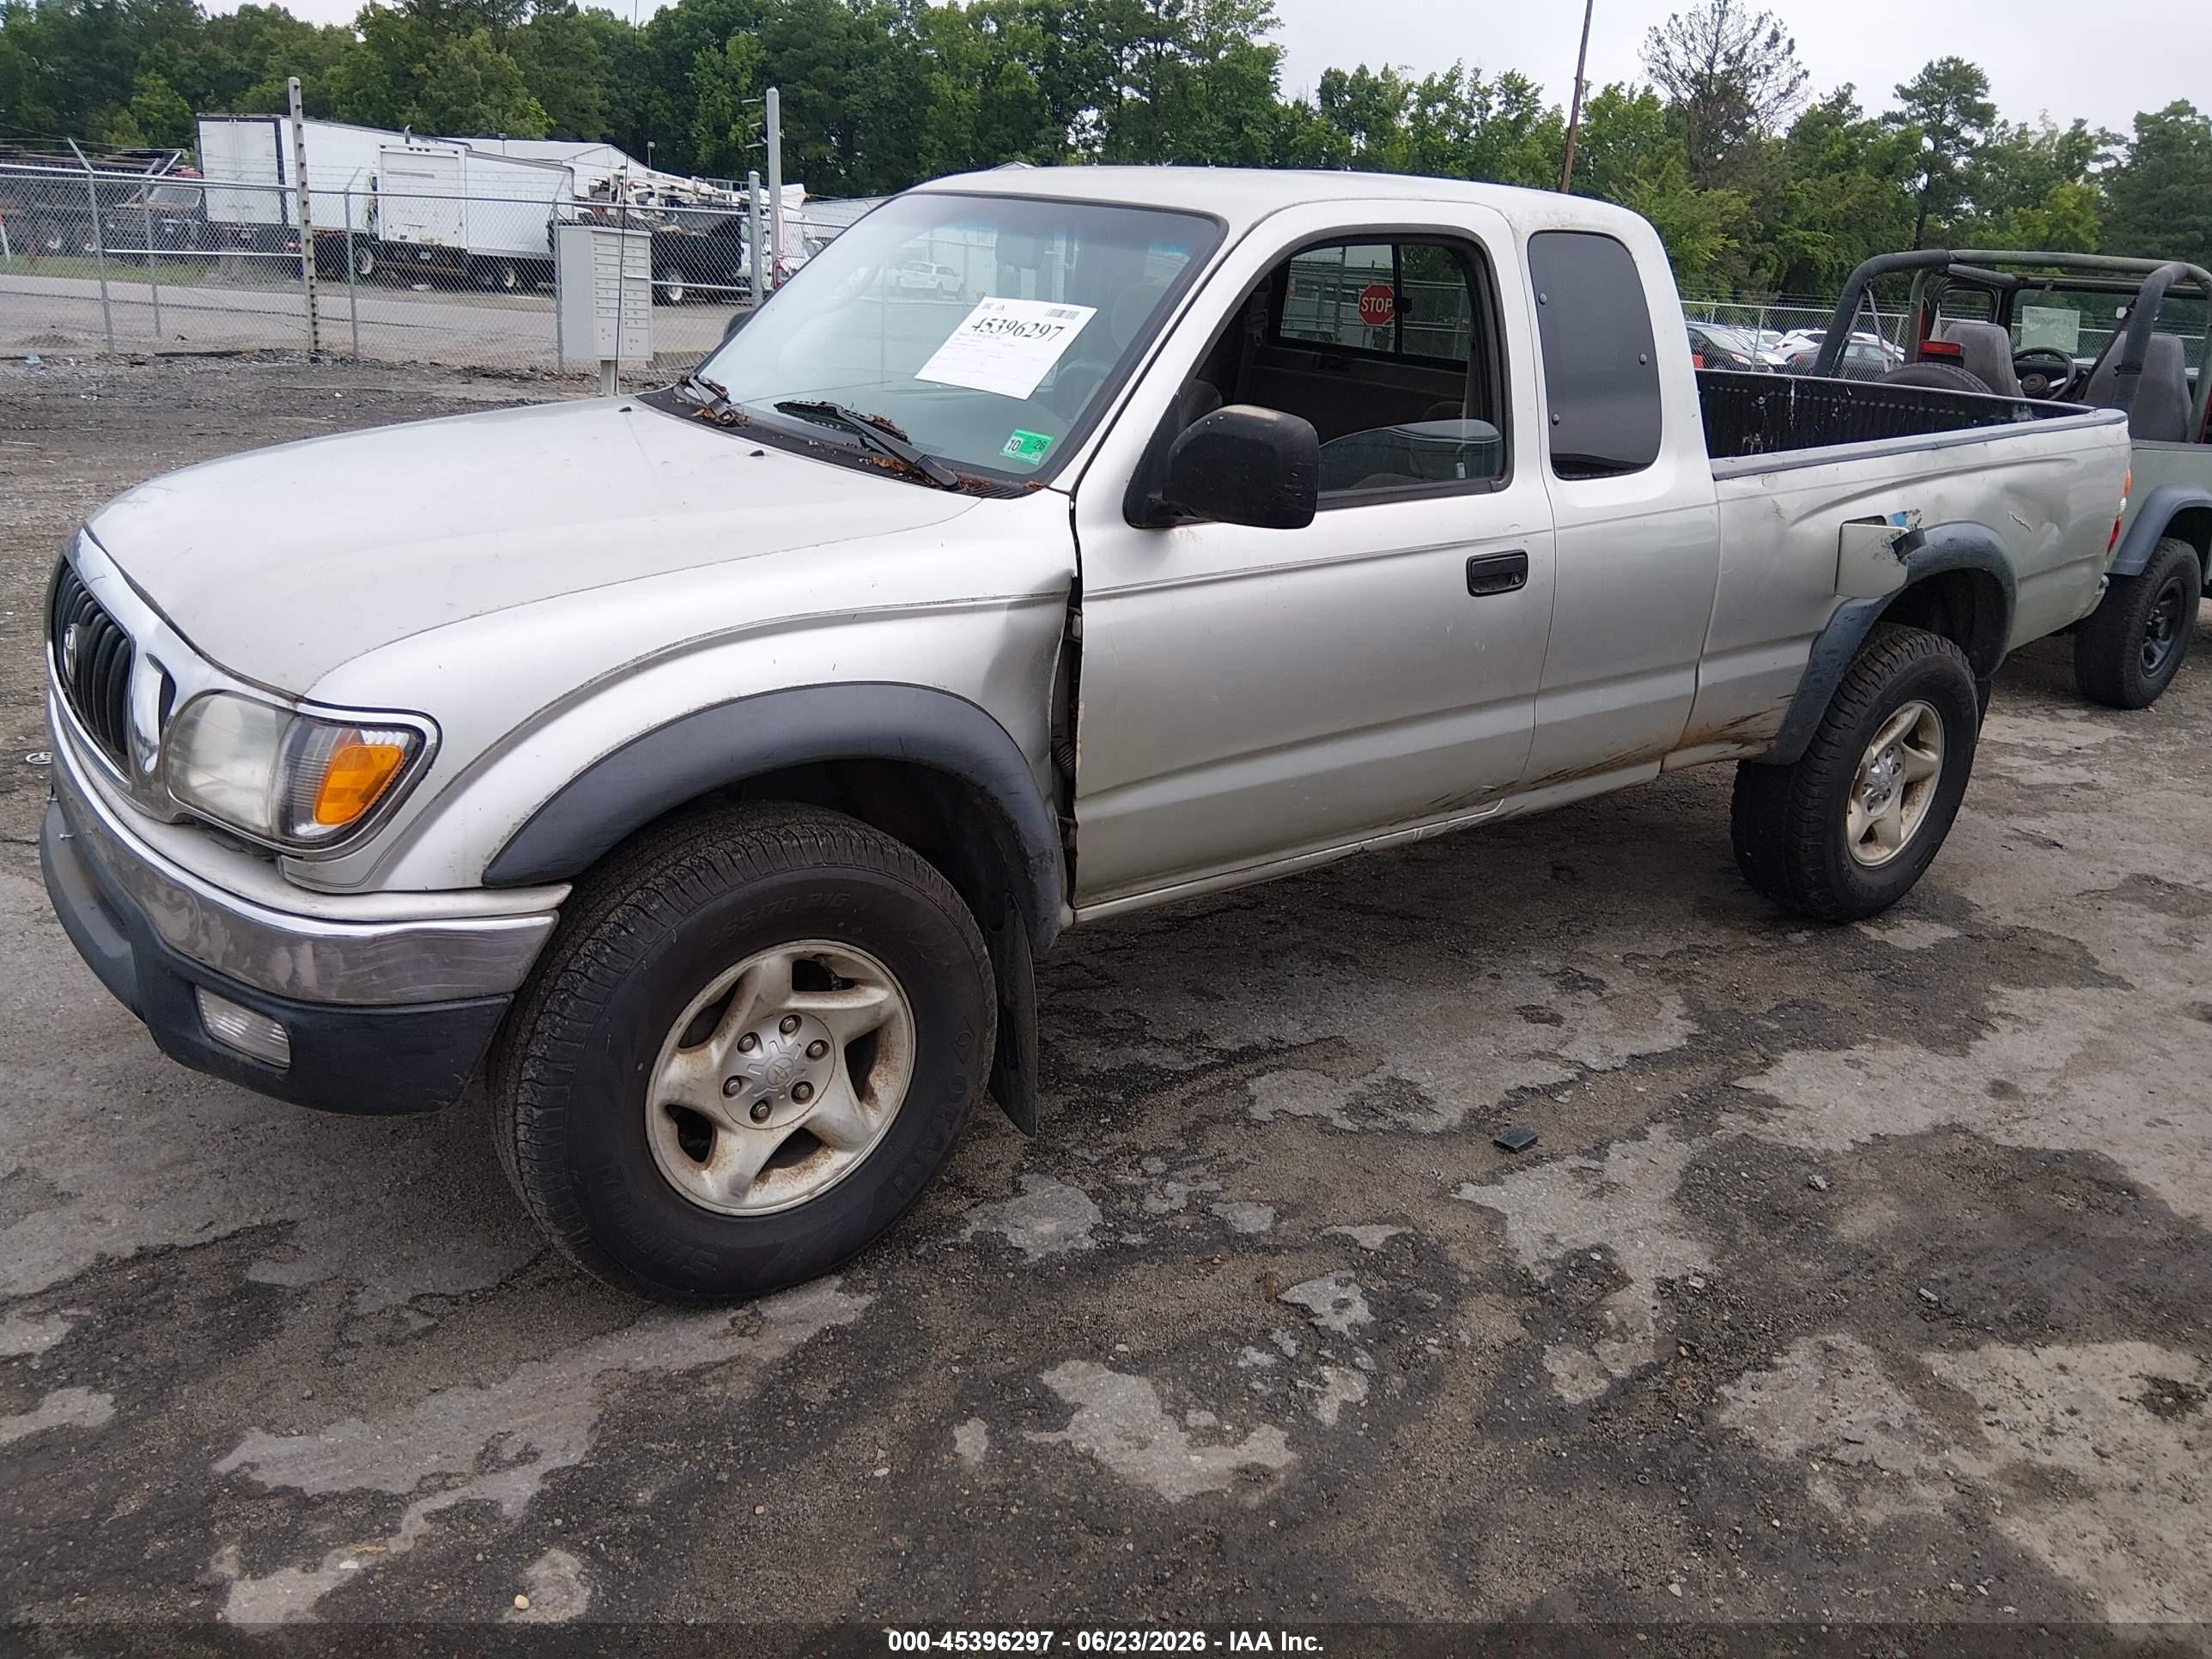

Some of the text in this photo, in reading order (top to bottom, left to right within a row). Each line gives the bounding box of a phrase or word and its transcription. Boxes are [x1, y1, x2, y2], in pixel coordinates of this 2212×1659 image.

[1360, 297, 1393, 313] STOP
[971, 317, 1065, 342] 45396297
[1007, 439, 1048, 453] 10 26
